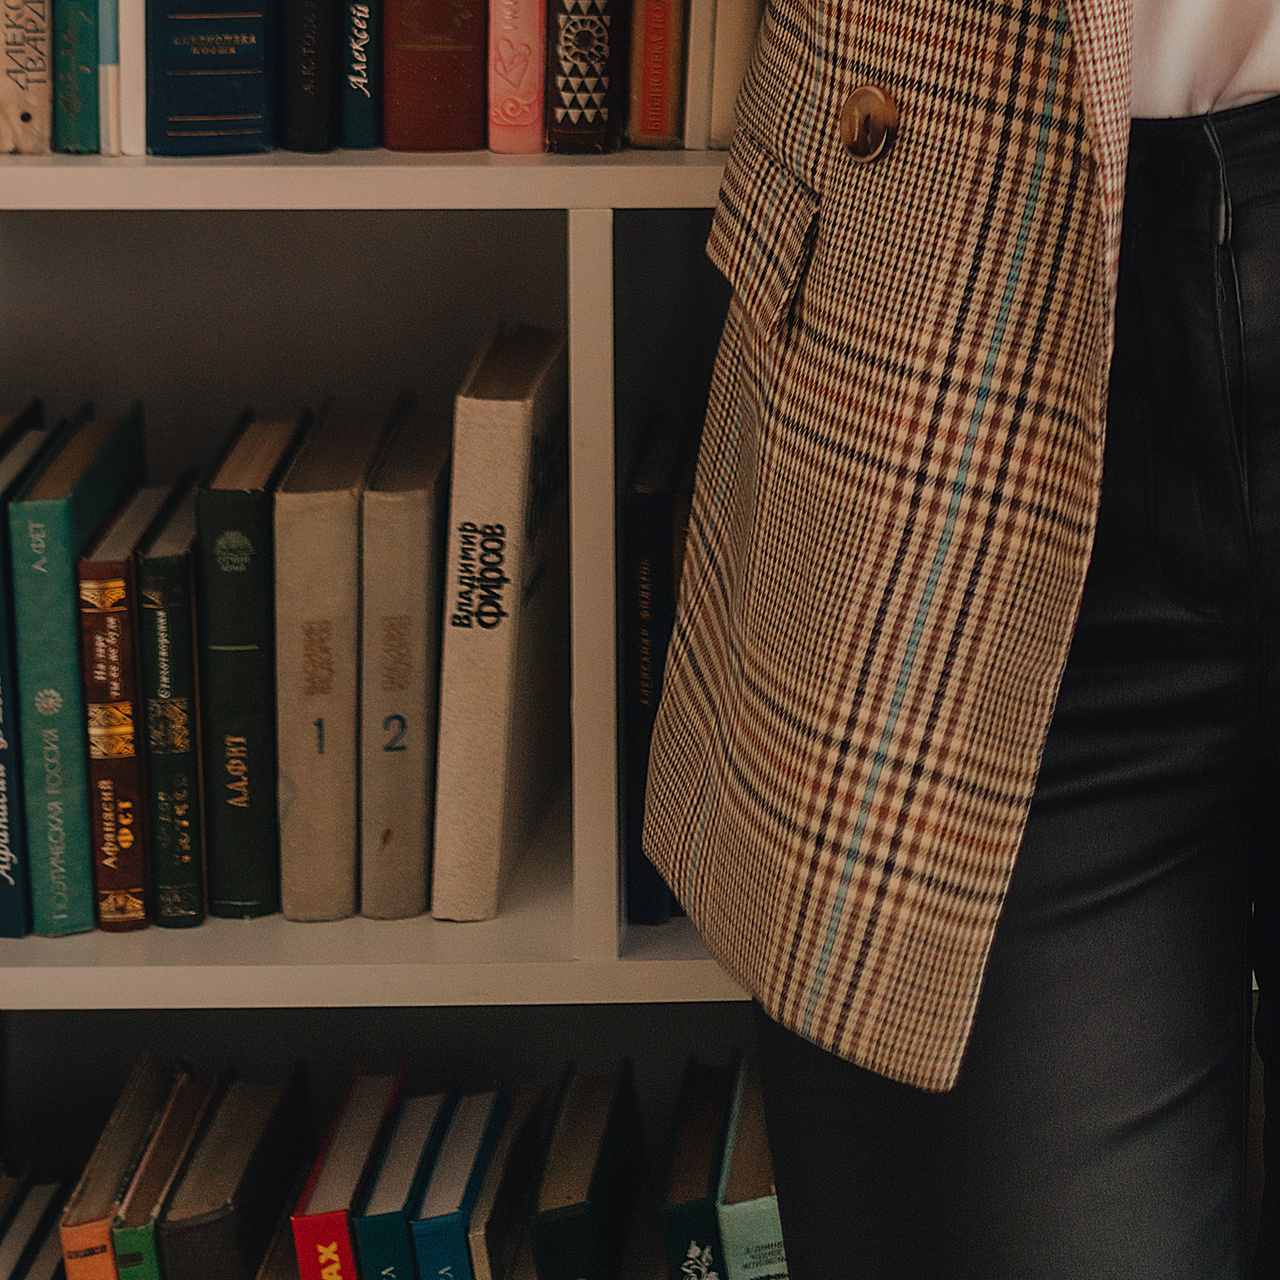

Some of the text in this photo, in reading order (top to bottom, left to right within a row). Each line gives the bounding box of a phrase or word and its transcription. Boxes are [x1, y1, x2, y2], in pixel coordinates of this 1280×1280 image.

[347, 3, 373, 99] Алексей
[449, 522, 478, 630] Владимир
[155, 610, 172, 700] Стихотворения
[381, 713, 407, 754] 2
[97, 779, 119, 869] Афанасий
